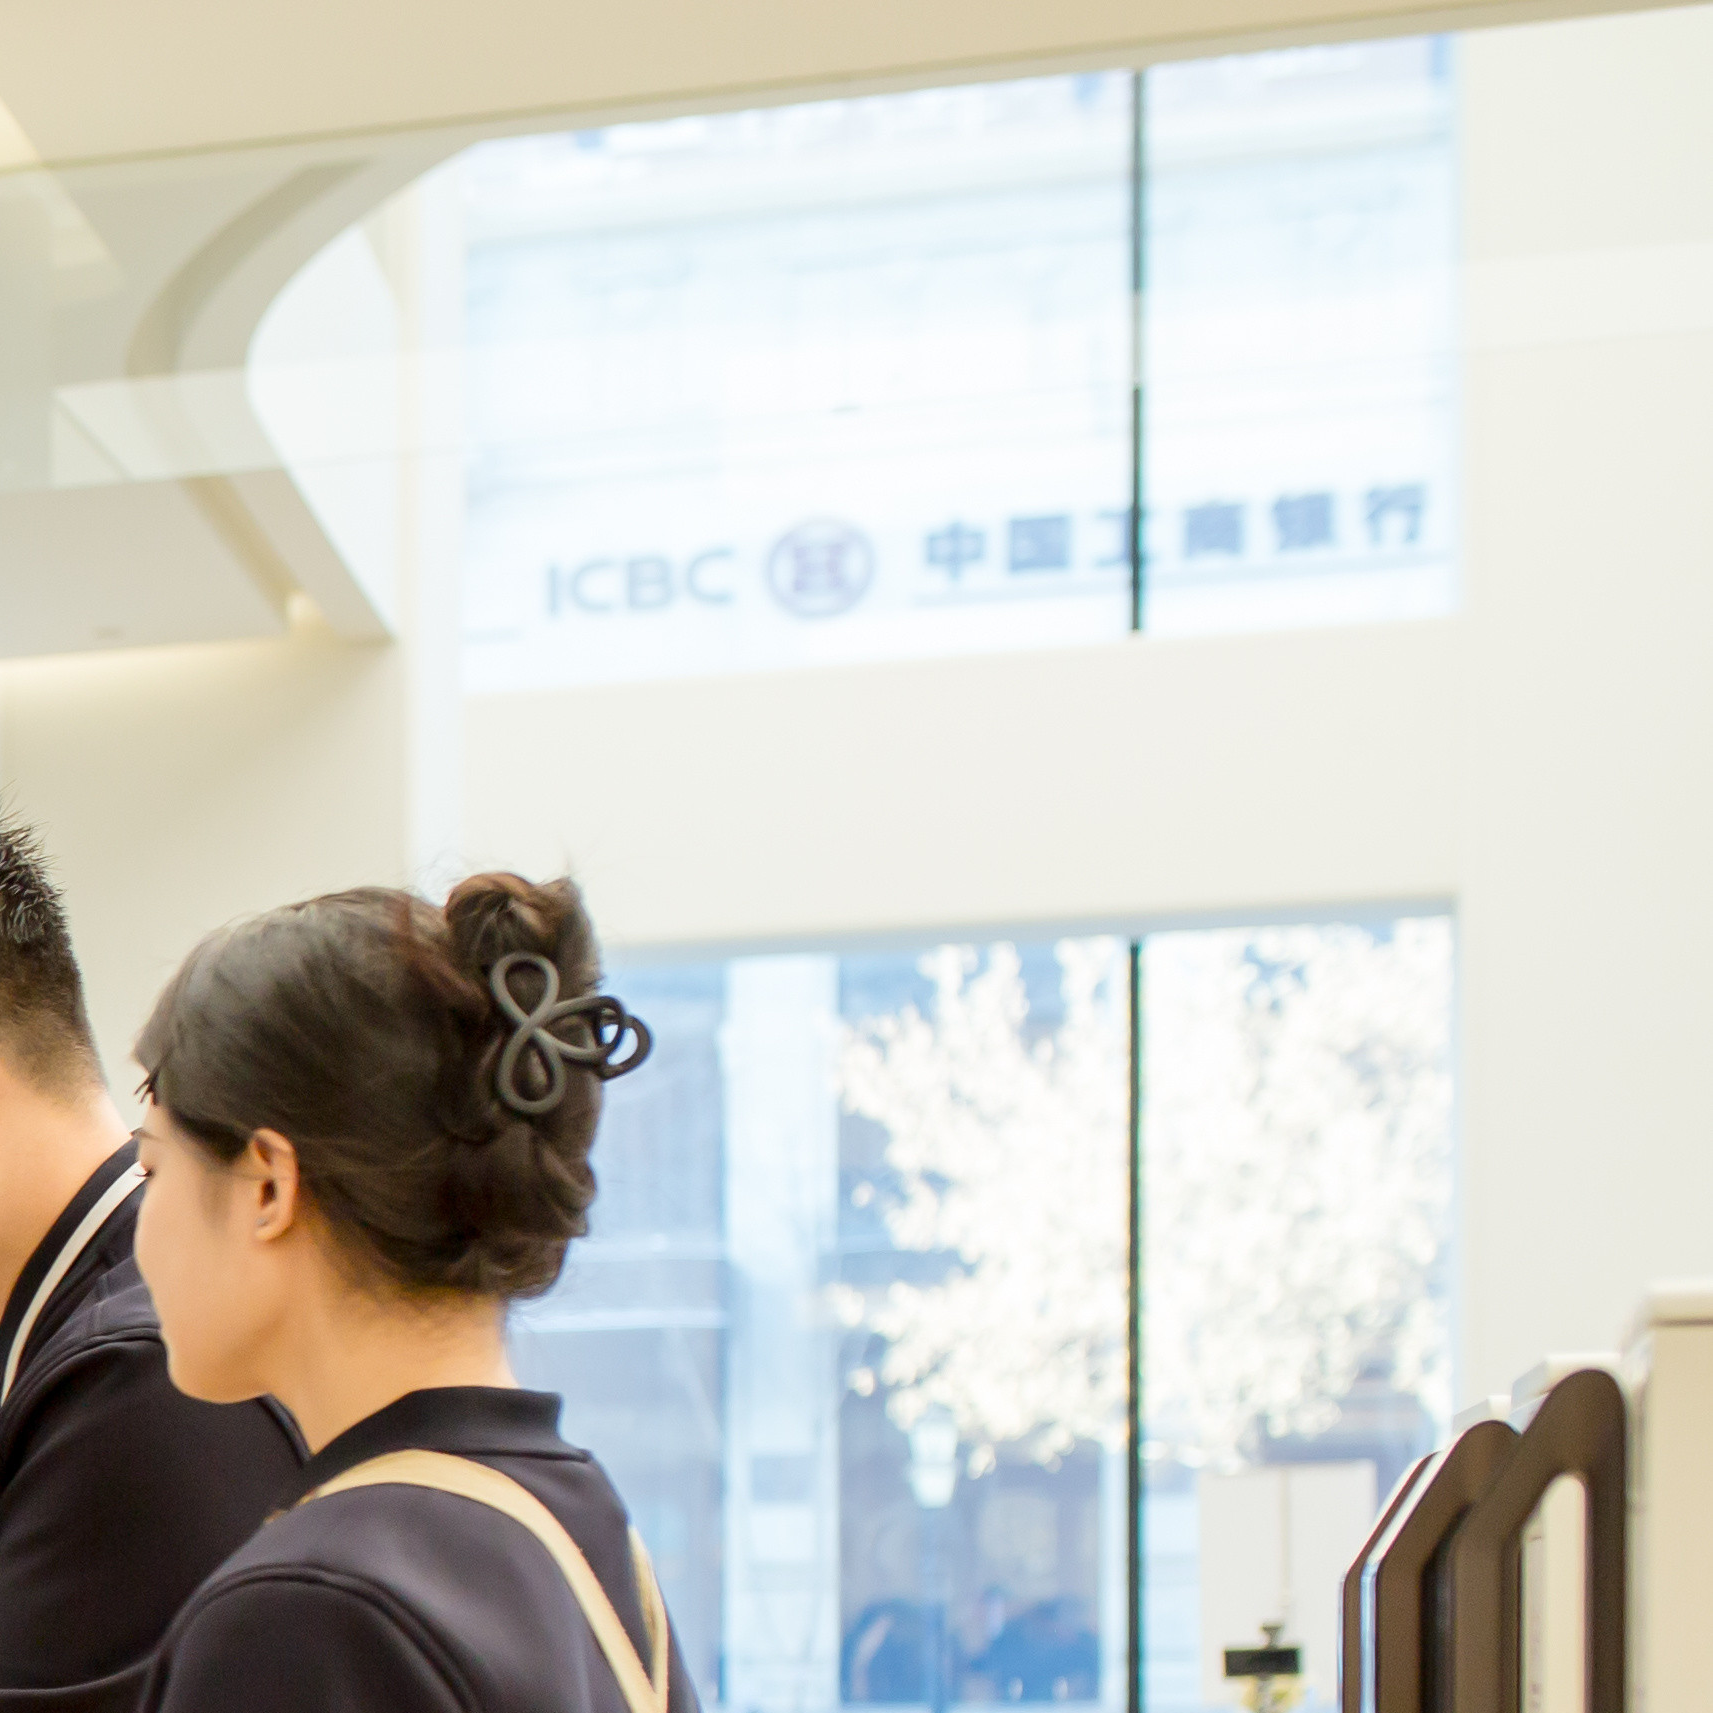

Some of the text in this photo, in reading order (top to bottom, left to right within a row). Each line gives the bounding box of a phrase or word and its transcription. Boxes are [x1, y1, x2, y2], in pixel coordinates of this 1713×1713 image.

[545, 483, 1426, 617] ICBC 中国工商银行
